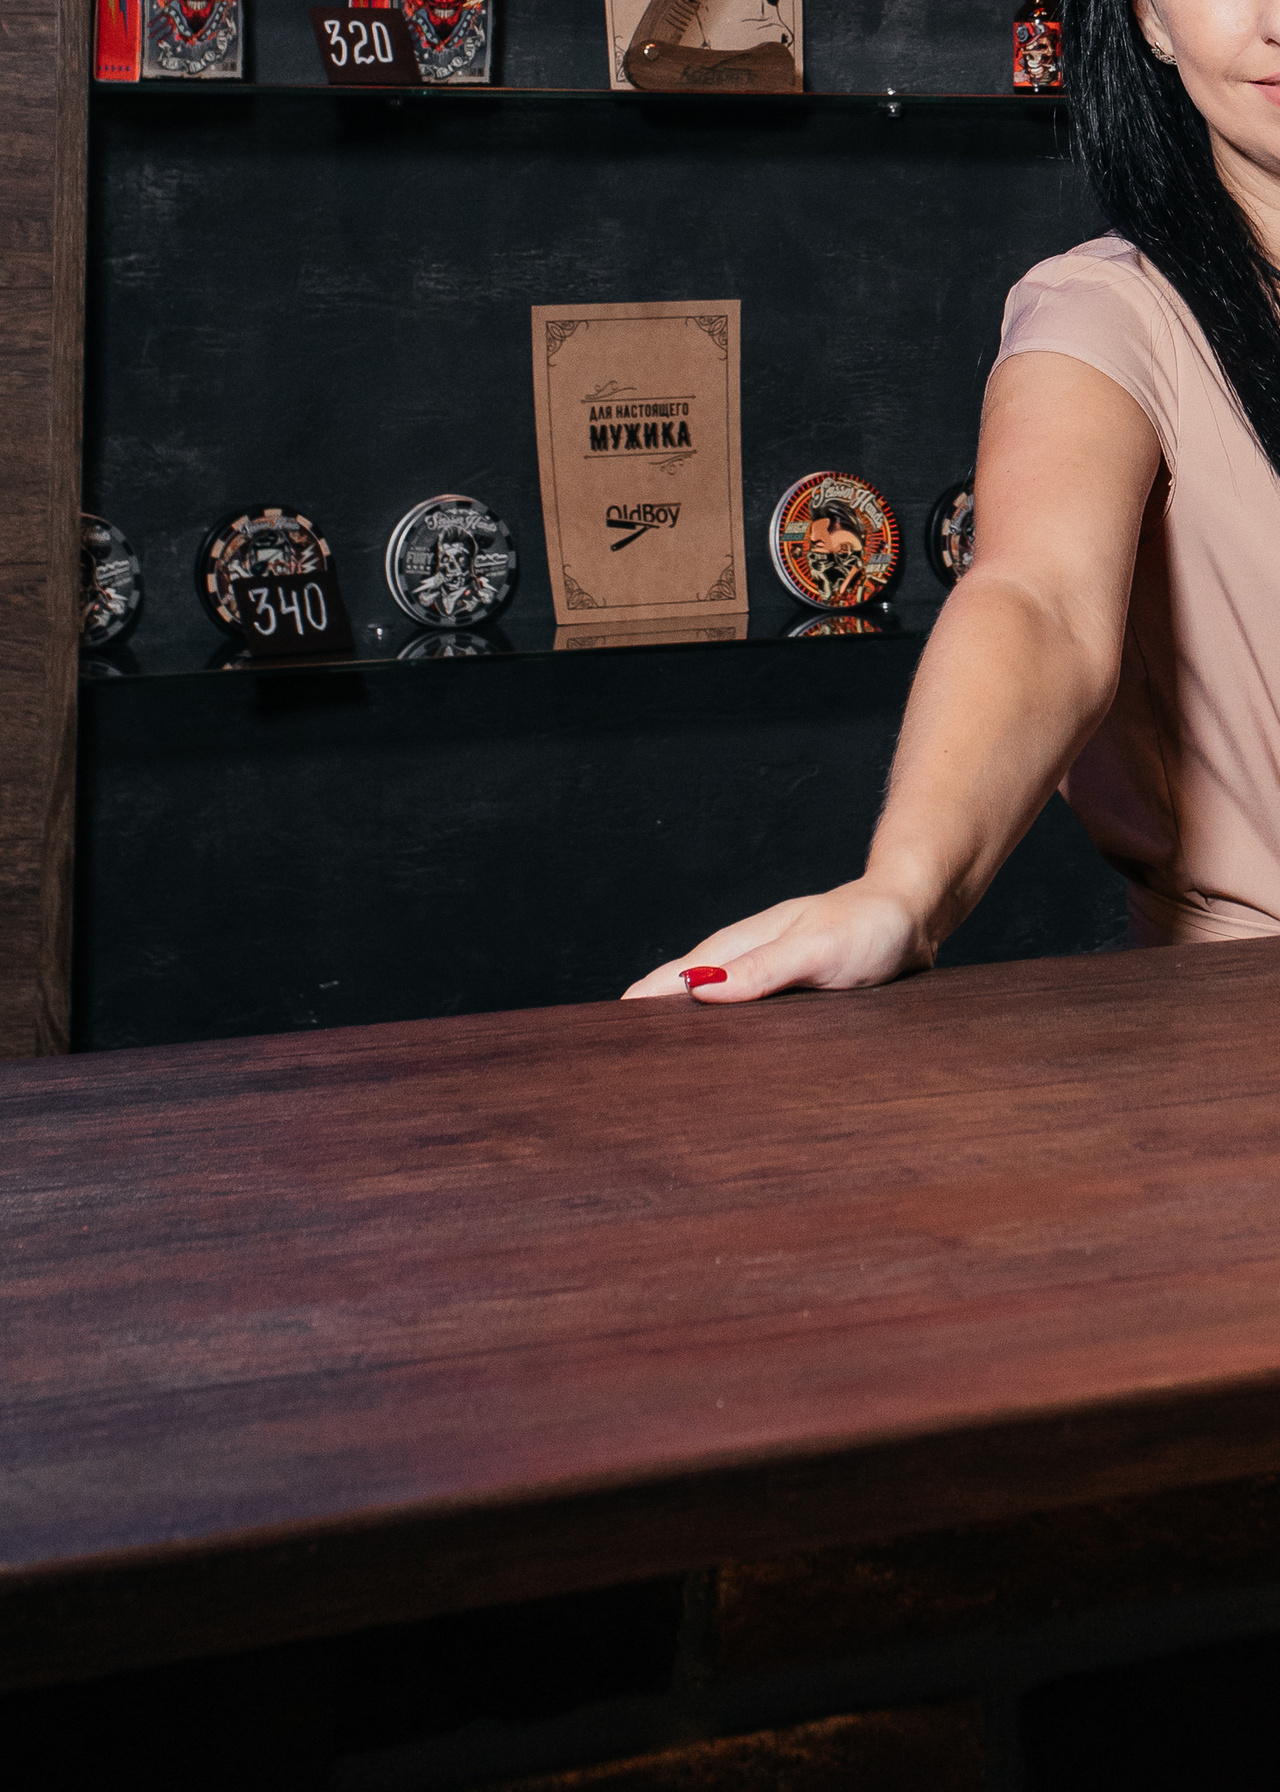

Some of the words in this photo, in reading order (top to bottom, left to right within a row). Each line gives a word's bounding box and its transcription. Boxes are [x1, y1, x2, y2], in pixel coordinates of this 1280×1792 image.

[324, 19, 394, 67] 320
[589, 406, 612, 422] ДЛЯ
[616, 402, 689, 419] НАСТОЯЩЕГО
[589, 421, 692, 451] МУЖИКА
[606, 503, 681, 528] OldBoy
[248, 582, 327, 635] 340
